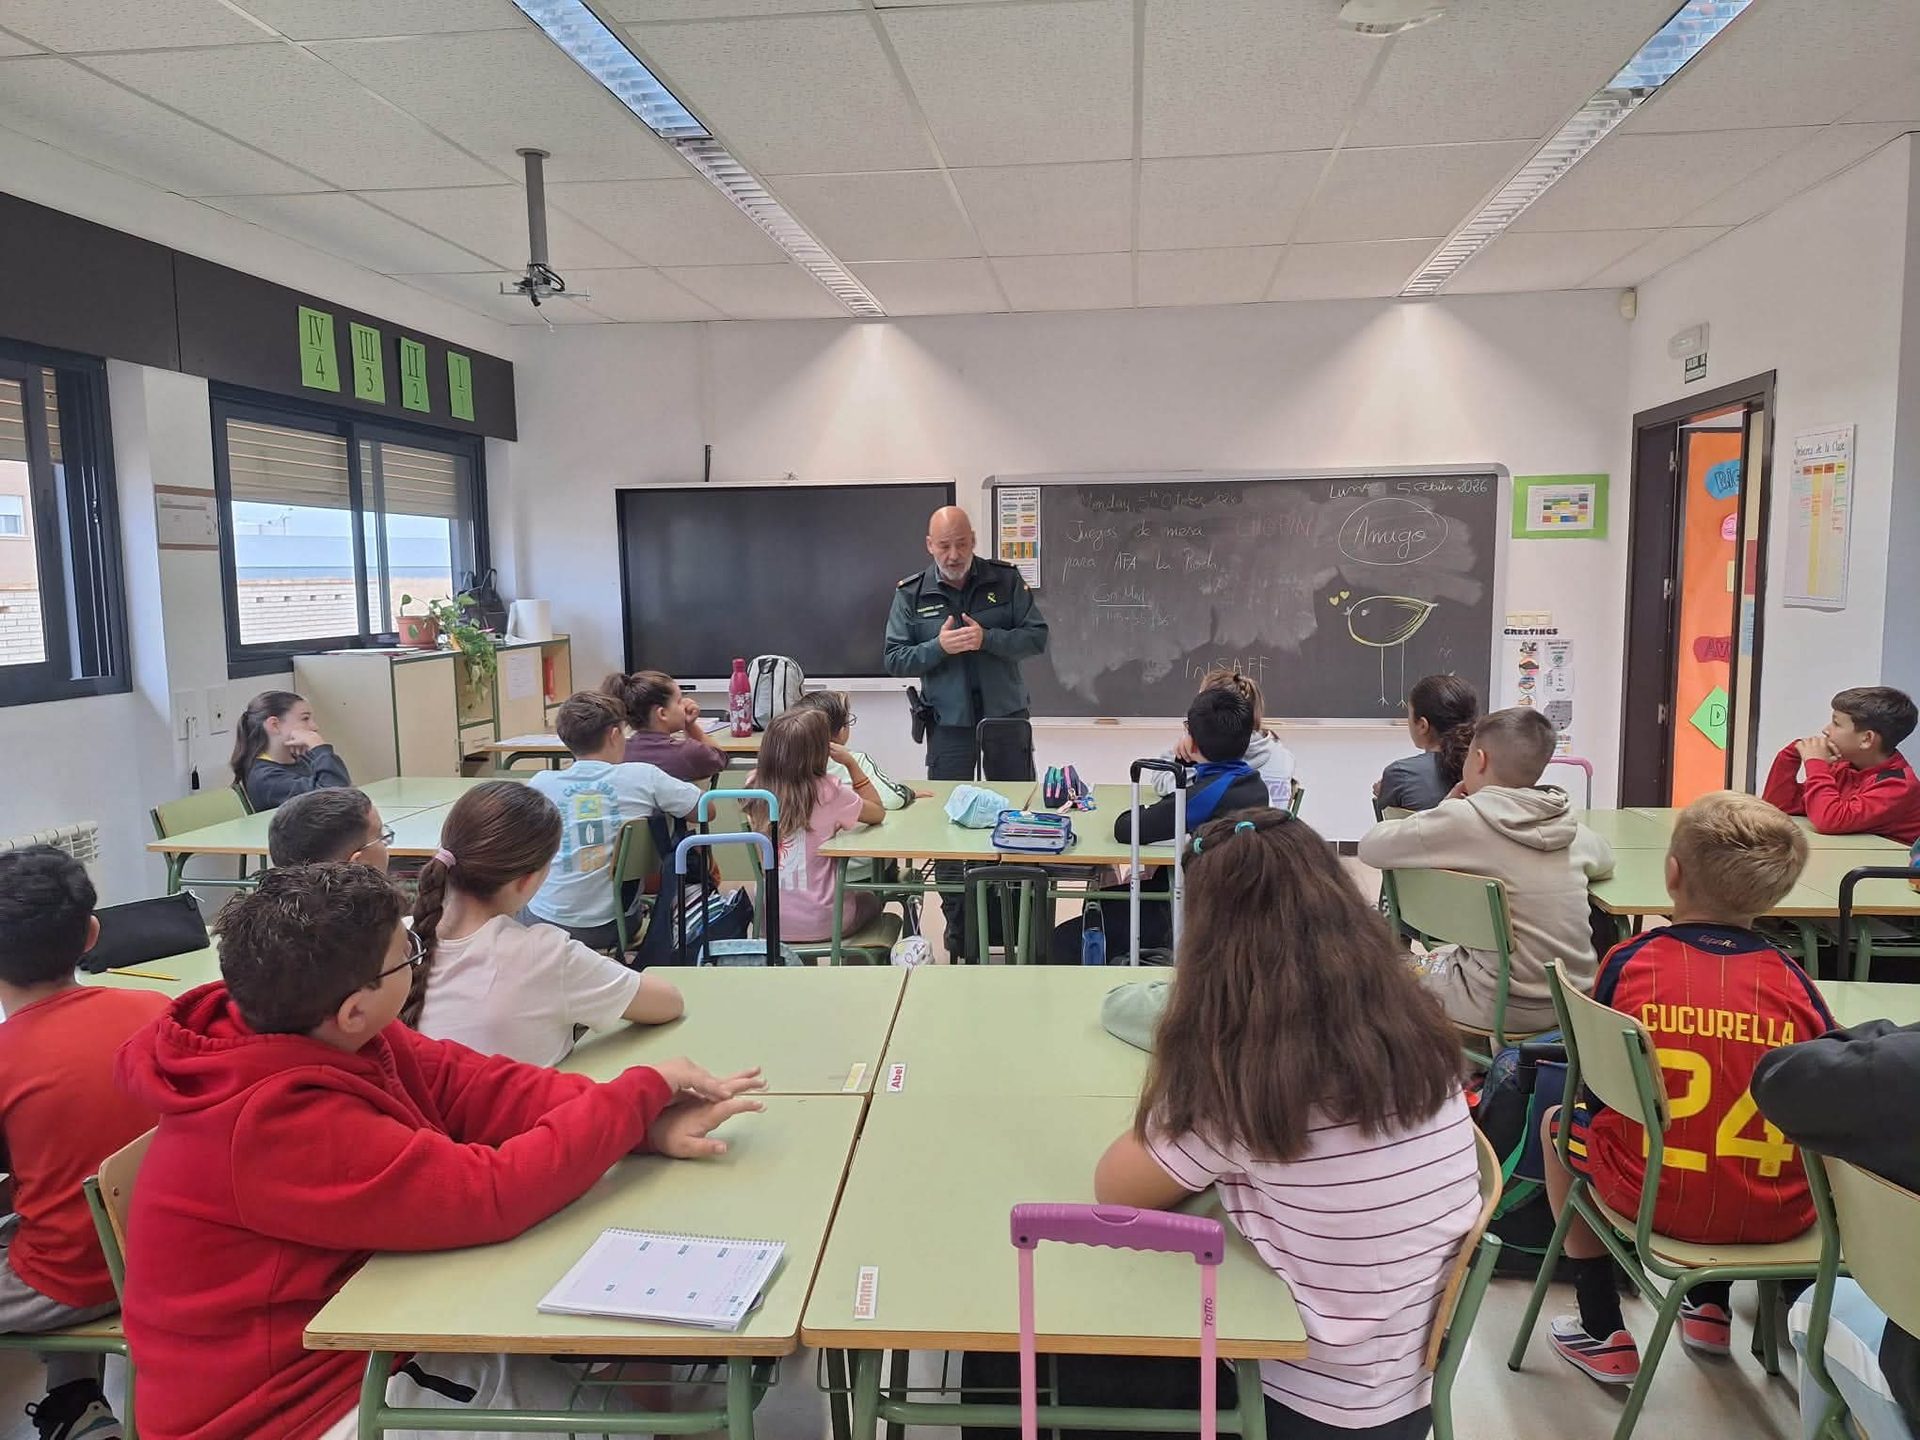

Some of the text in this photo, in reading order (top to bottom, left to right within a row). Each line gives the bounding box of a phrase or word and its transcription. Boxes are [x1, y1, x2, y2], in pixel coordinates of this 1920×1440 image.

[308, 315, 325, 347] IV
[359, 330, 375, 362] III
[315, 354, 325, 382] 4
[406, 345, 420, 378] II
[366, 366, 374, 392] 3
[413, 383, 420, 404] 2
[1067, 520, 1118, 549] Juegos
[1166, 527, 1203, 538] mesa
[1355, 516, 1427, 559] Amigo
[1063, 556, 1097, 584] para
[1503, 628, 1559, 636] GREETINGS
[1710, 703, 1727, 727] D
[1641, 1003, 1795, 1048] CUCURELLA
[891, 1066, 904, 1089] Abel
[1643, 1047, 1795, 1177] 24
[855, 1272, 874, 1316] Emma
